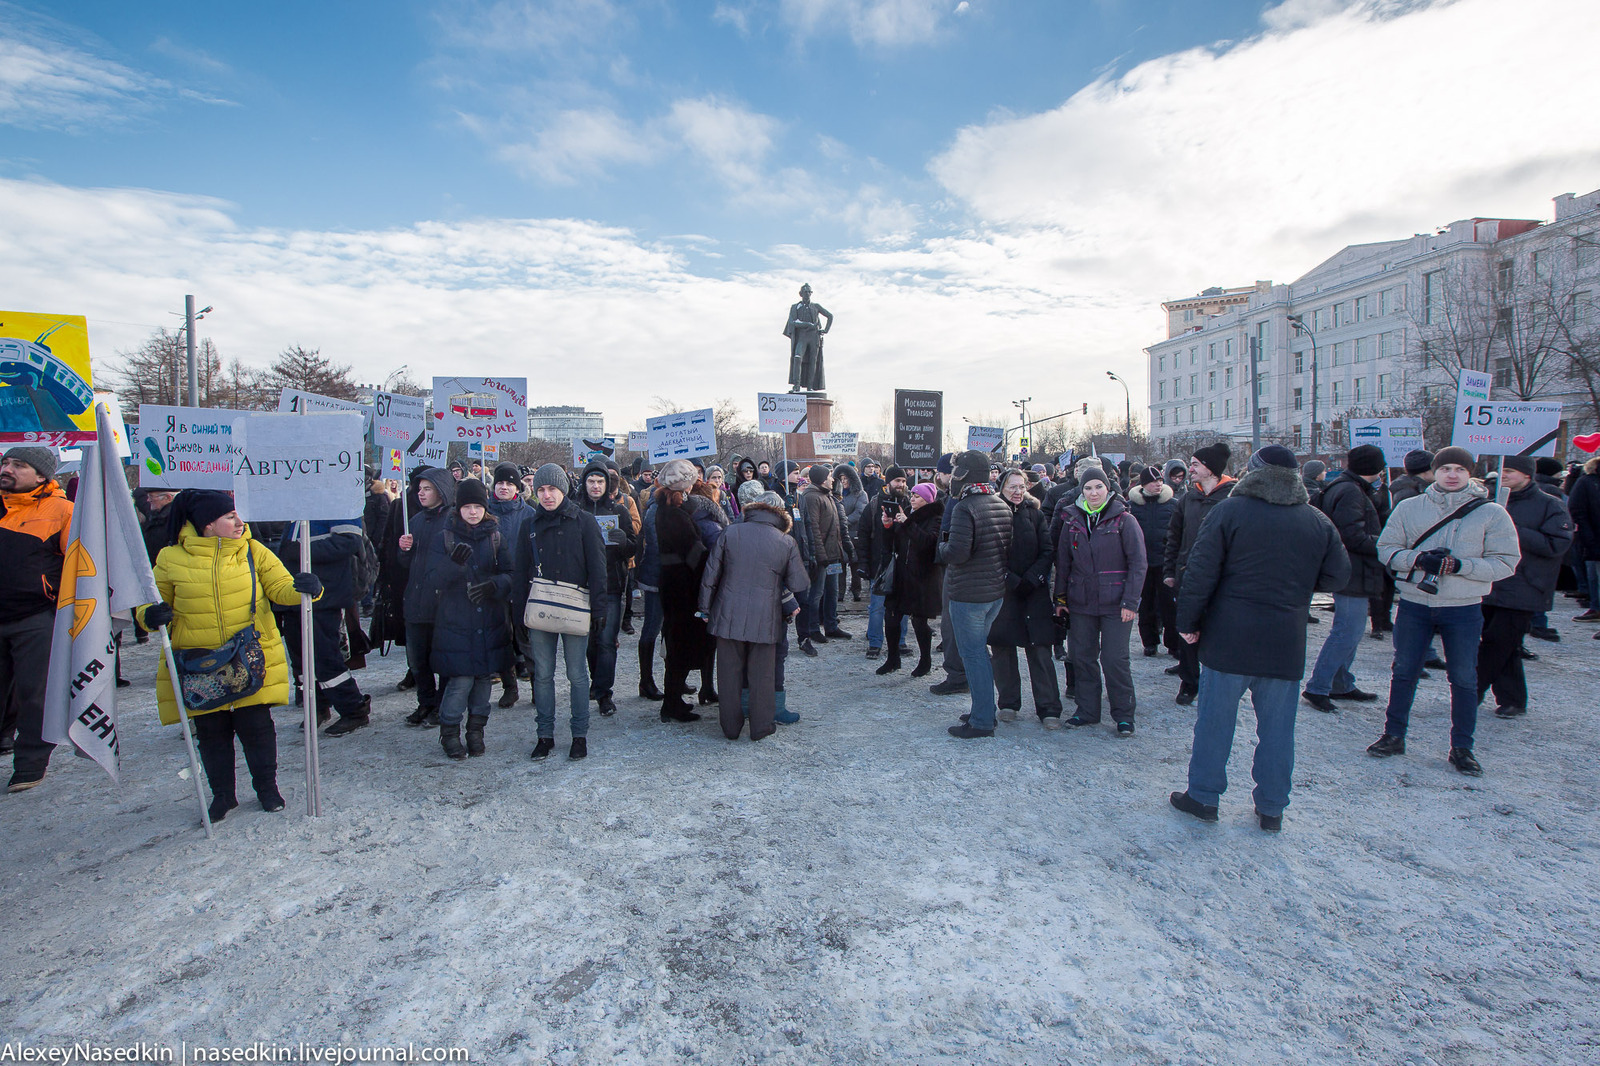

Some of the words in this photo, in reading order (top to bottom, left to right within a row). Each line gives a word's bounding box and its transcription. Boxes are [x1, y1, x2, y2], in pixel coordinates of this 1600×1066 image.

[376, 393, 392, 418] 67
[760, 396, 777, 412] 25
[1463, 405, 1493, 426] 15
[1496, 417, 1525, 425] ВДНХ
[165, 416, 175, 433] Я
[665, 427, 699, 438] РОГАТЫЙ
[1468, 435, 1525, 445] 1941-2016
[209, 444, 220, 454] НА
[180, 460, 230, 474] ПОСЛЕДНИЙ
